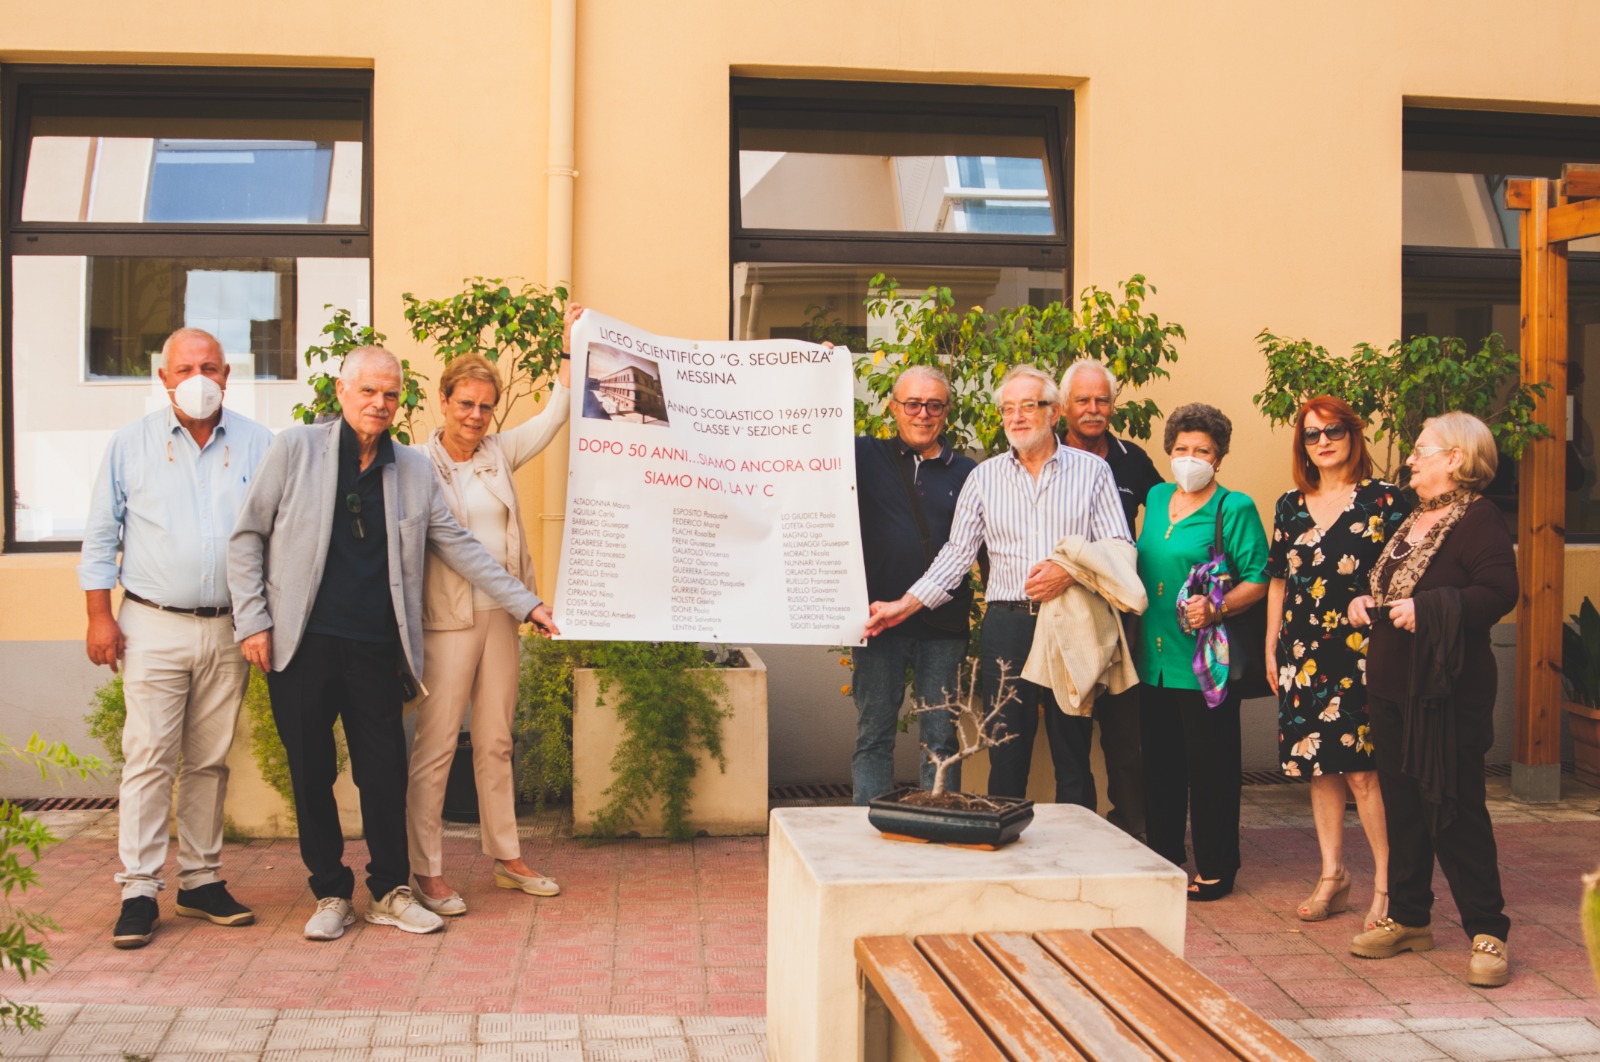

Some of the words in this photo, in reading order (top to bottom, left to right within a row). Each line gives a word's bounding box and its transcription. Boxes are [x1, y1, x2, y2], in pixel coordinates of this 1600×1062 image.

[600, 327, 632, 349] LICEO
[636, 342, 714, 366] SCIENTIFICO
[677, 369, 736, 384] MESSINA
[667, 400, 697, 416] ANNO
[701, 408, 773, 420] SCOLASTICO
[780, 408, 842, 420] 1969/1970
[694, 421, 729, 435] CLASSE
[748, 425, 797, 436] SEZIONE
[802, 424, 811, 435] C
[579, 438, 622, 454] DOPO
[629, 444, 646, 458] 50
[740, 459, 803, 472] ANCORA
[808, 458, 842, 471] QUI!
[644, 470, 692, 488] SIAMO
[698, 477, 726, 494] NOI,
[728, 481, 743, 494] LA
[764, 484, 774, 496] C
[573, 498, 610, 507] ALTADONNA
[673, 508, 702, 517] ESPOSITO
[704, 511, 728, 519] Pasquale
[792, 512, 817, 520] GIUDICE
[572, 518, 599, 526] BARBARO
[601, 520, 628, 529] Giuseppe
[673, 518, 702, 527] FEDERICO
[571, 528, 600, 536] BRIGANTE
[602, 530, 625, 539] Giorgio
[695, 530, 715, 538] Rosalba
[571, 538, 602, 547] CALABRESE
[690, 539, 715, 548] Giuseppe
[570, 548, 595, 556] CARDILE
[596, 550, 625, 558] Francesco
[672, 547, 703, 556] GALATOLO
[704, 550, 729, 558] Vincenzo
[569, 558, 593, 566] CARDILE
[596, 560, 615, 568] Grazia
[568, 568, 598, 576] CARDILLO
[601, 570, 618, 578] Enrico
[673, 566, 702, 575] GUERRERA
[704, 569, 729, 577] Giacomo
[568, 578, 588, 586] CARINI
[720, 579, 744, 587] Pasquale
[567, 588, 597, 597] CIPRIANO
[672, 586, 699, 594] GURRIERI
[700, 588, 721, 597] Giorgio
[577, 609, 609, 617] FRANCISCI
